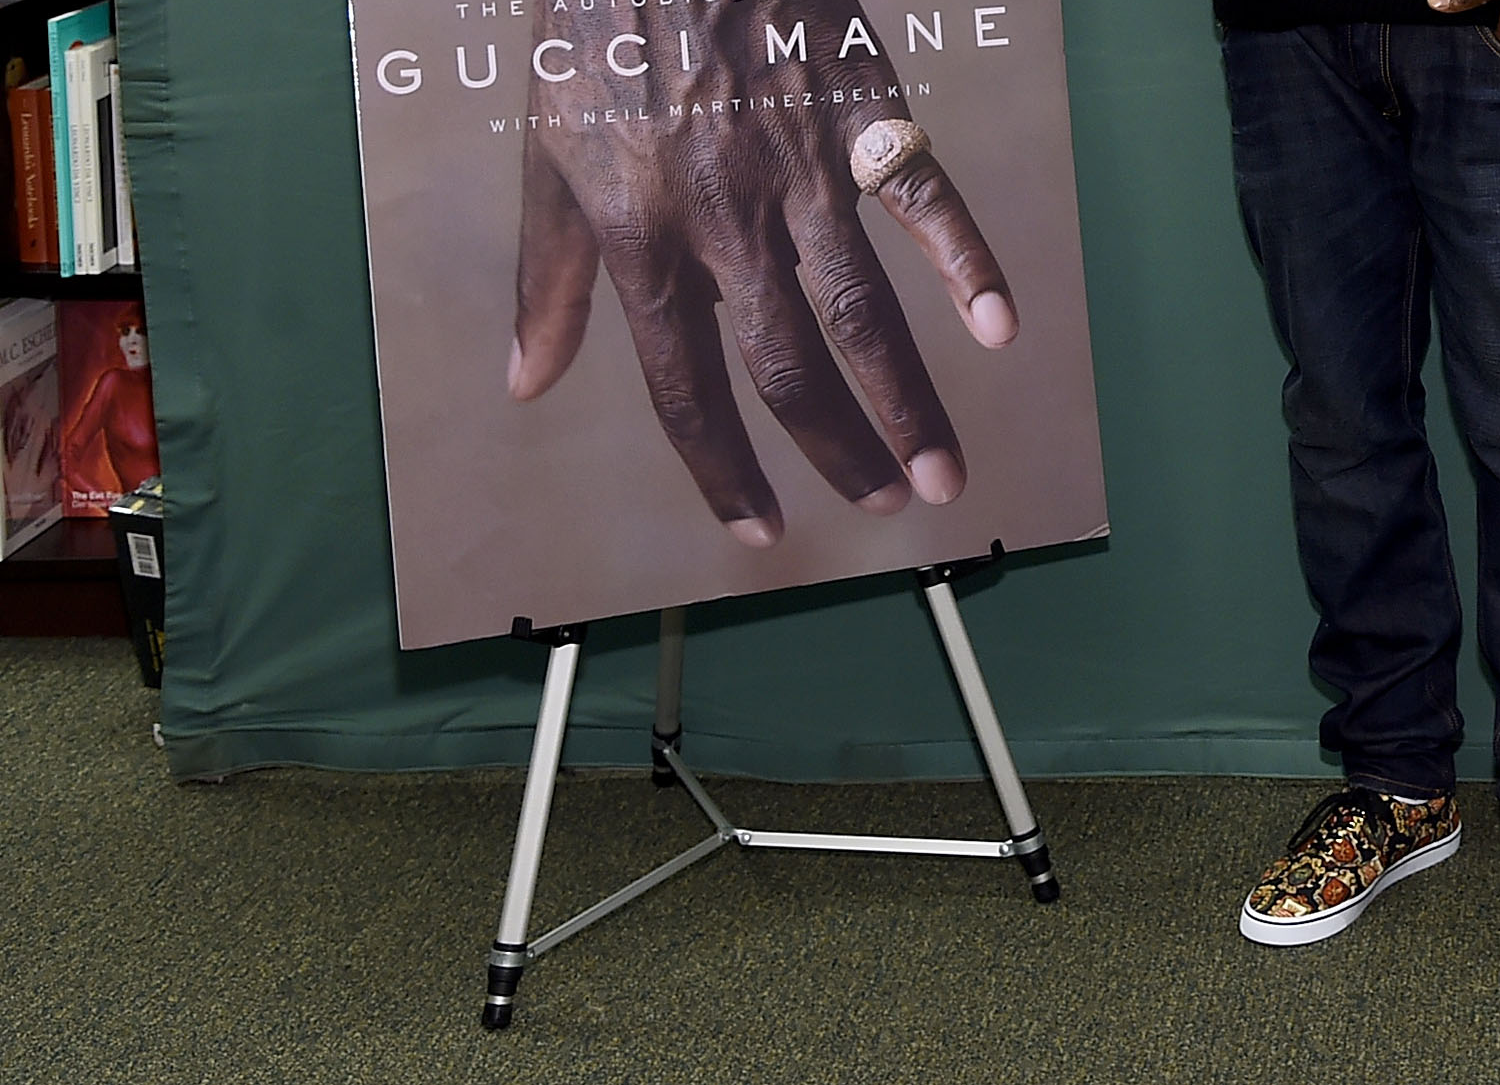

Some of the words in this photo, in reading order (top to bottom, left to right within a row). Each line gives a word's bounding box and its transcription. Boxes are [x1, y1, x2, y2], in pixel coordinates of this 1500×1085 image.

[457, 0, 525, 20] THE
[375, 29, 692, 95] GUCCI
[764, 6, 1010, 65] MANE
[489, 114, 563, 133] WITH
[583, 107, 650, 125] NEIL
[668, 81, 933, 117] MARTINEZ-BELKIN
